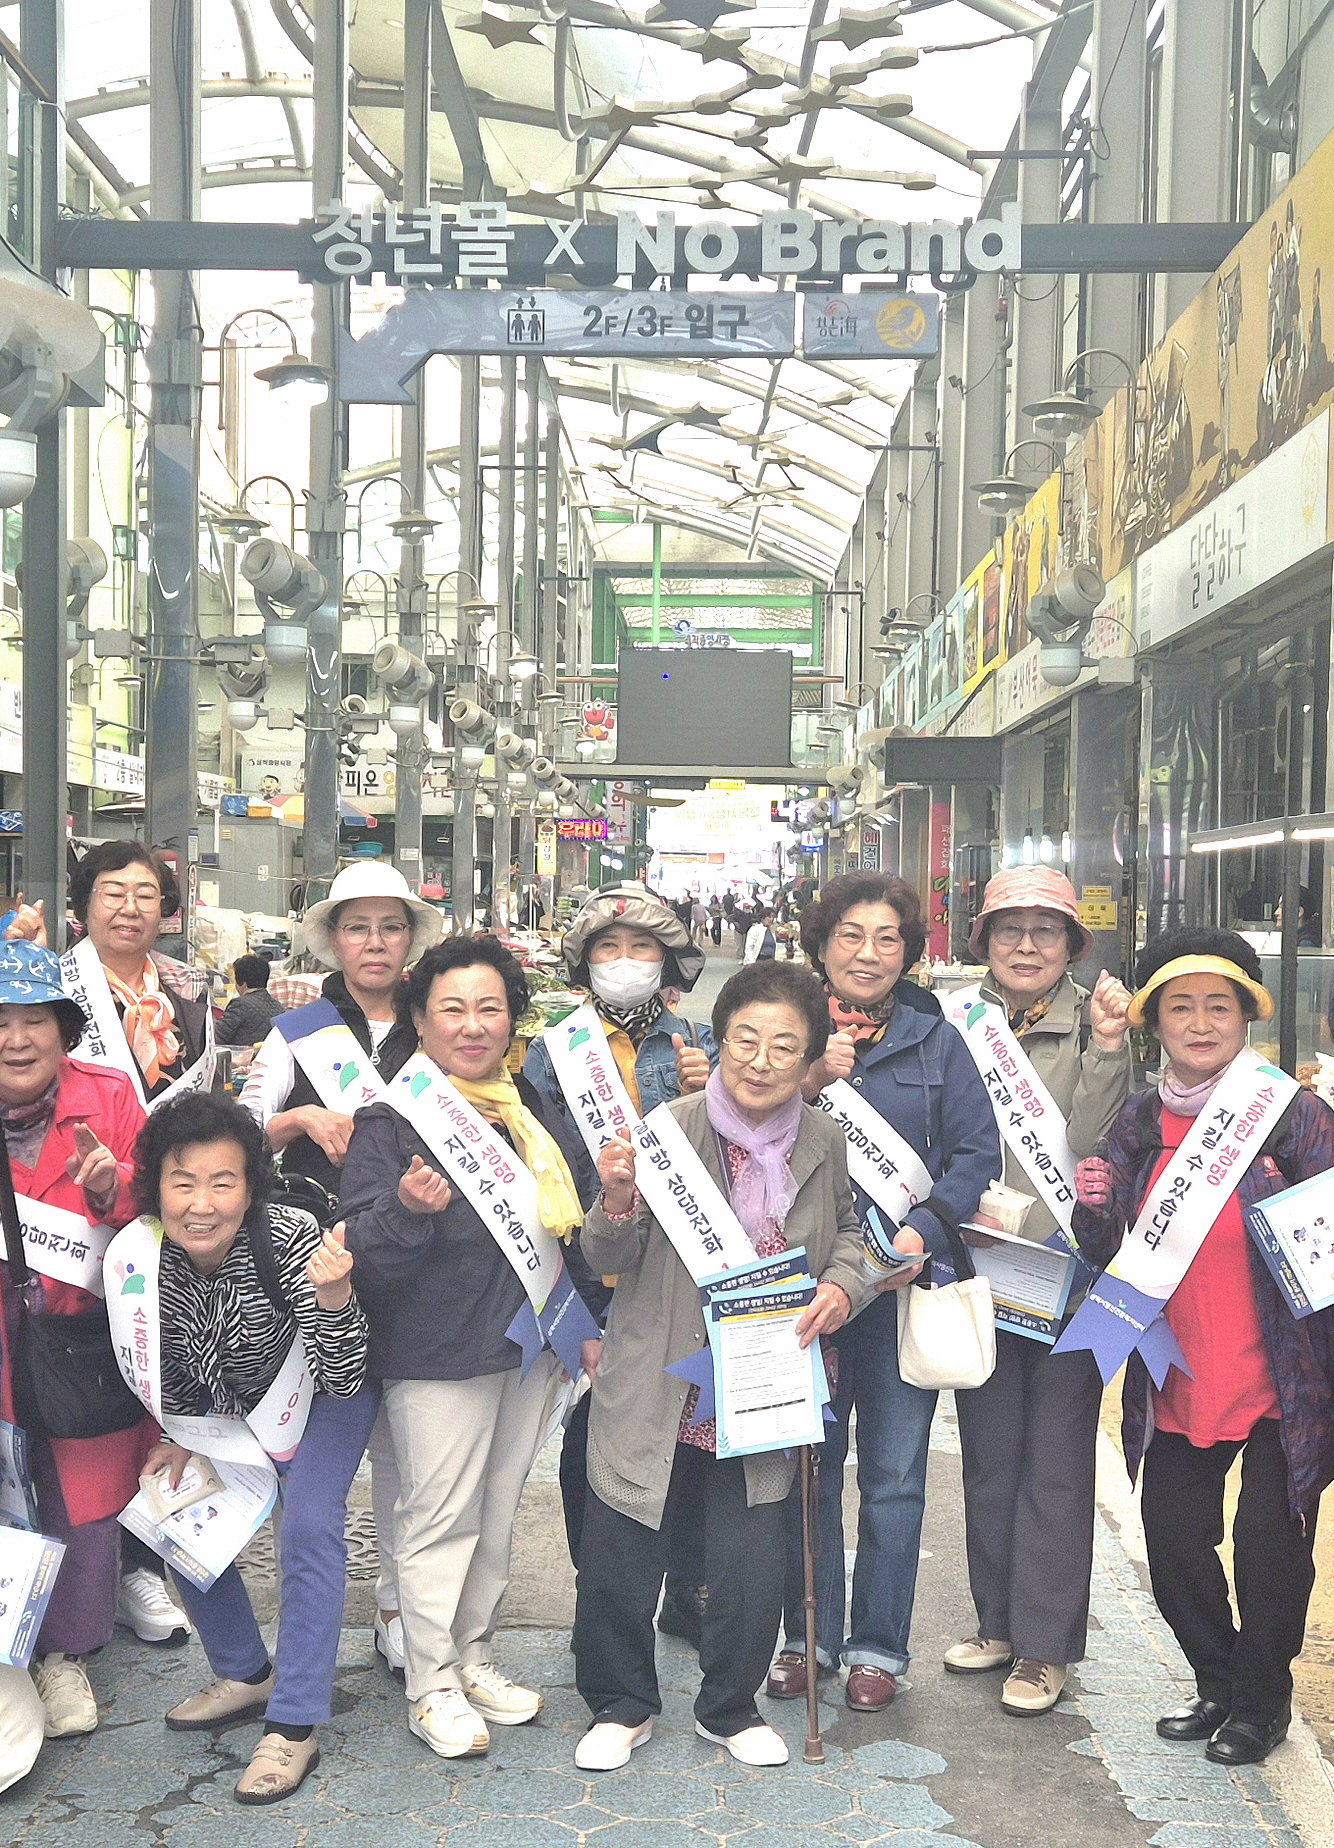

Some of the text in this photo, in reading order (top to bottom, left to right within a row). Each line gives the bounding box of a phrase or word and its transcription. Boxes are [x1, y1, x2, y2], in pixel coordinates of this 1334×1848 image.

[310, 199, 517, 277] 청년몰
[616, 210, 742, 275] No
[759, 201, 1023, 275] Brand
[582, 302, 752, 341] 2F/3F 입구
[578, 1089, 607, 1130] 지킬
[584, 1050, 615, 1102] 소중한
[983, 1024, 1045, 1119] 소중한 생명
[434, 1092, 517, 1185] 소중한 생명
[835, 1110, 900, 1180] 상담전화
[983, 1066, 1014, 1107] 지킬
[1008, 1110, 1026, 1128] 수
[1020, 1130, 1074, 1204] 있습니다
[1206, 1086, 1276, 1187] 소중한 생명
[443, 1133, 543, 1272] 지킬 수 있습니다
[632, 1119, 725, 1257] 살예방 상담전화
[1143, 1107, 1236, 1252] 지킬 수 있습니다
[132, 1305, 150, 1373] 소중한
[276, 1371, 306, 1427] 109
